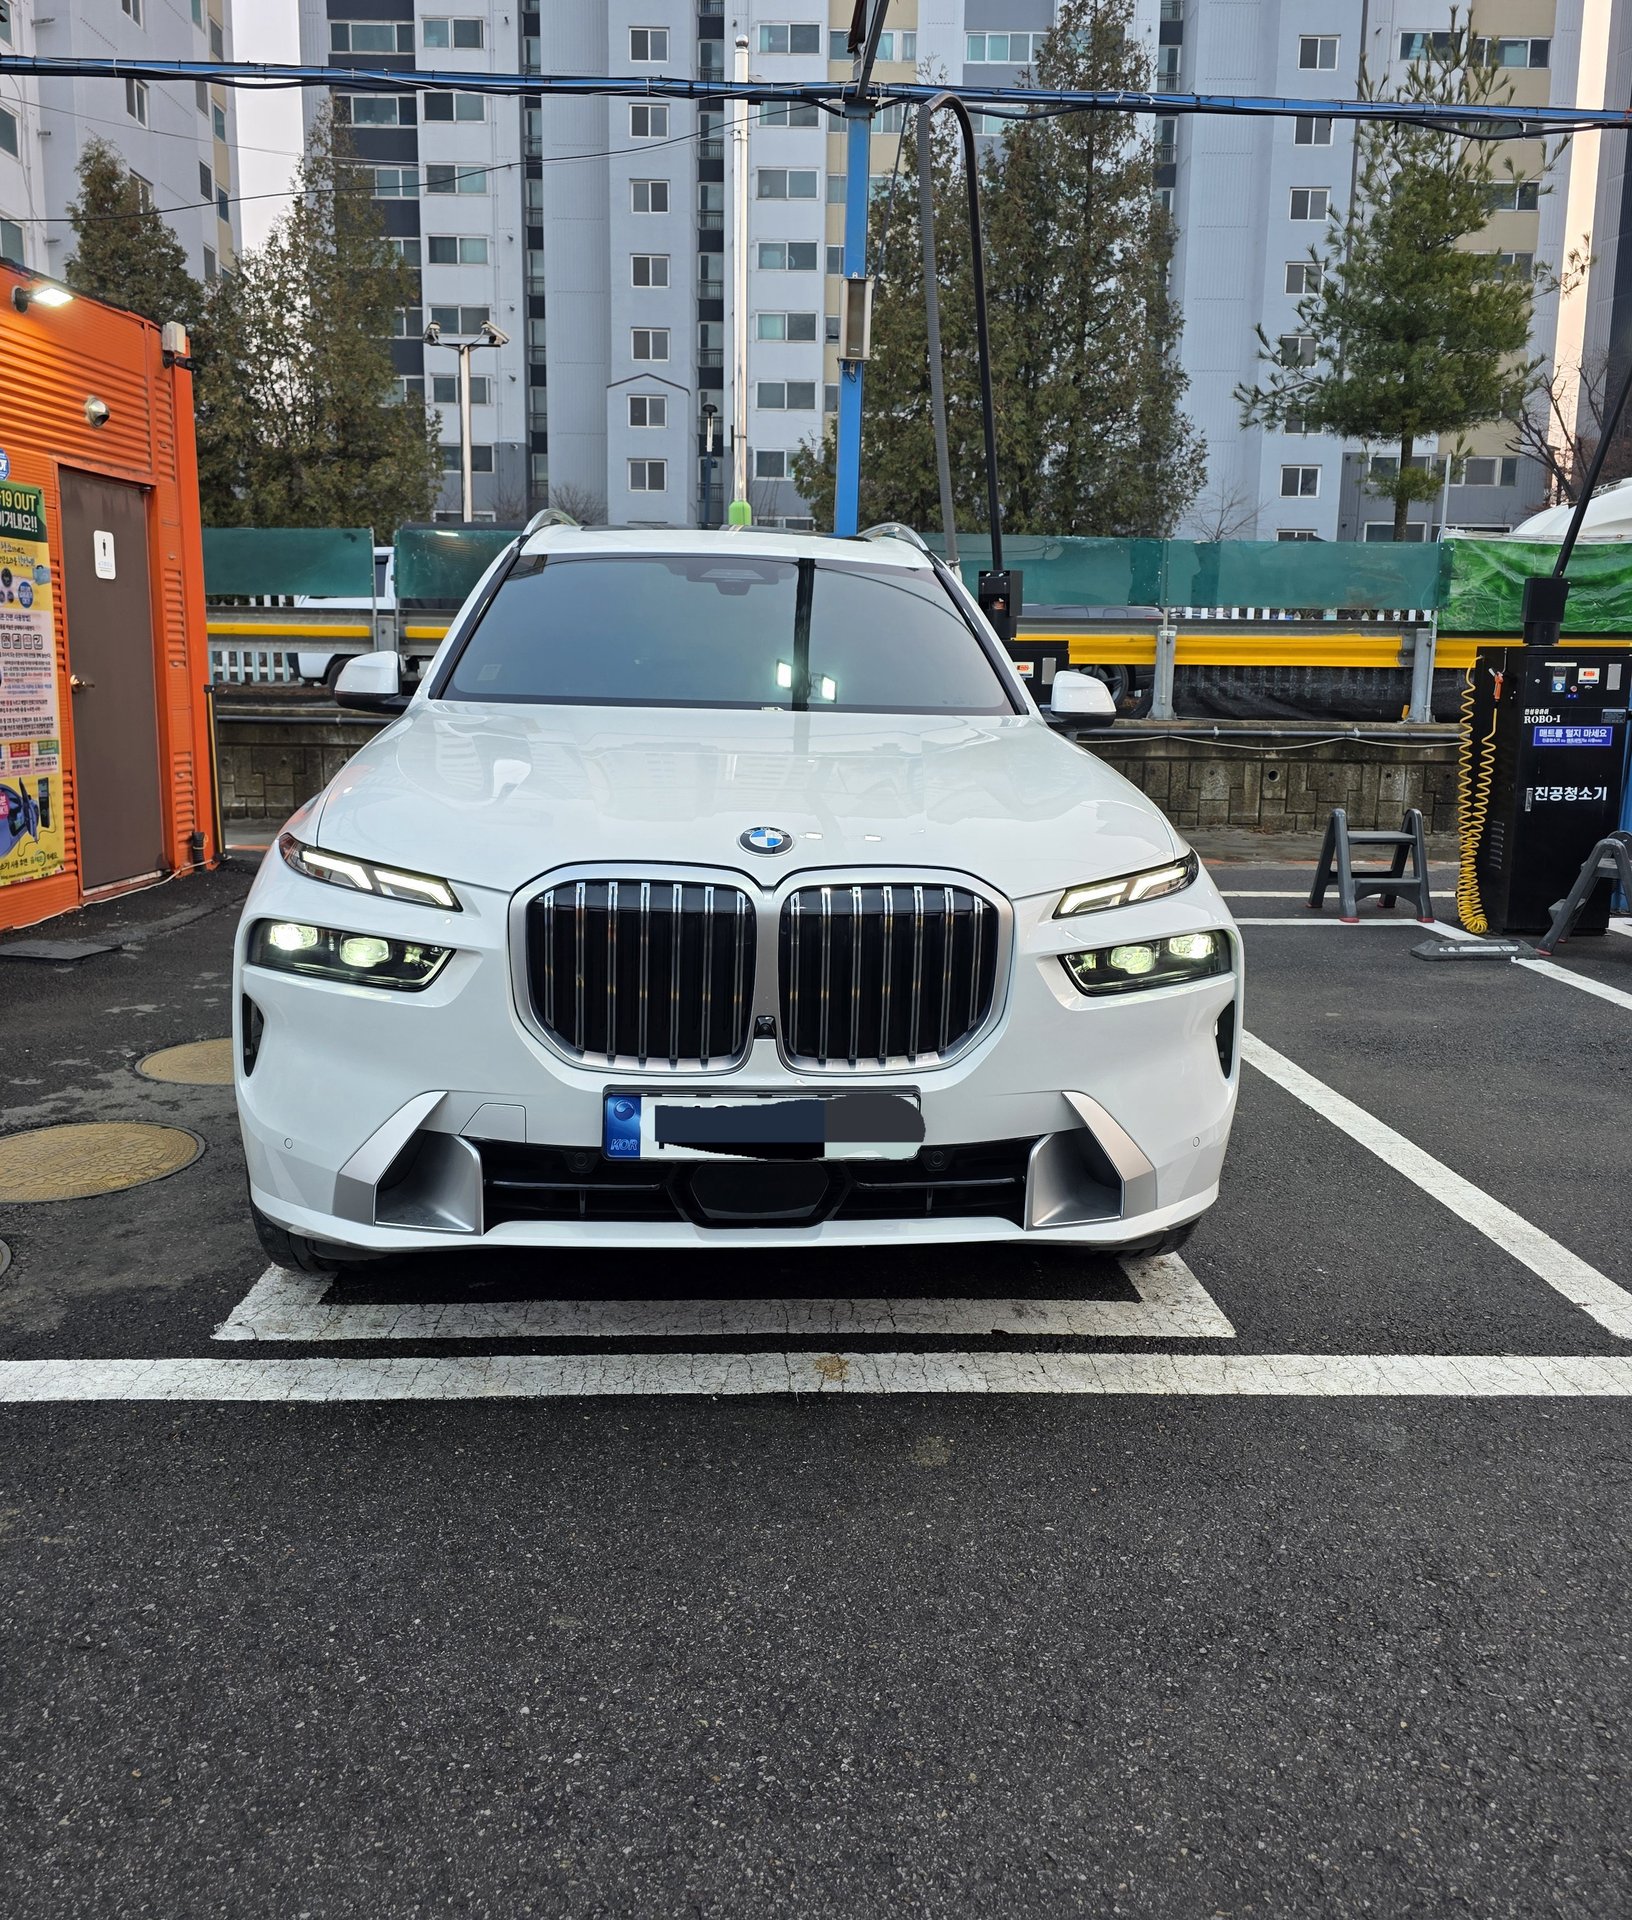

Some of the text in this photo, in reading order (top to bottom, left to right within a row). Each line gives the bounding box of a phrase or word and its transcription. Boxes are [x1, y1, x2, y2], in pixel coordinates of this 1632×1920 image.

[14, 492, 36, 512] OUT
[1524, 714, 1561, 724] ROBO-I
[1539, 728, 1607, 738] 매트를 털지 마세요
[1534, 786, 1608, 801] 진공청소기
[610, 1138, 638, 1151] KOR
